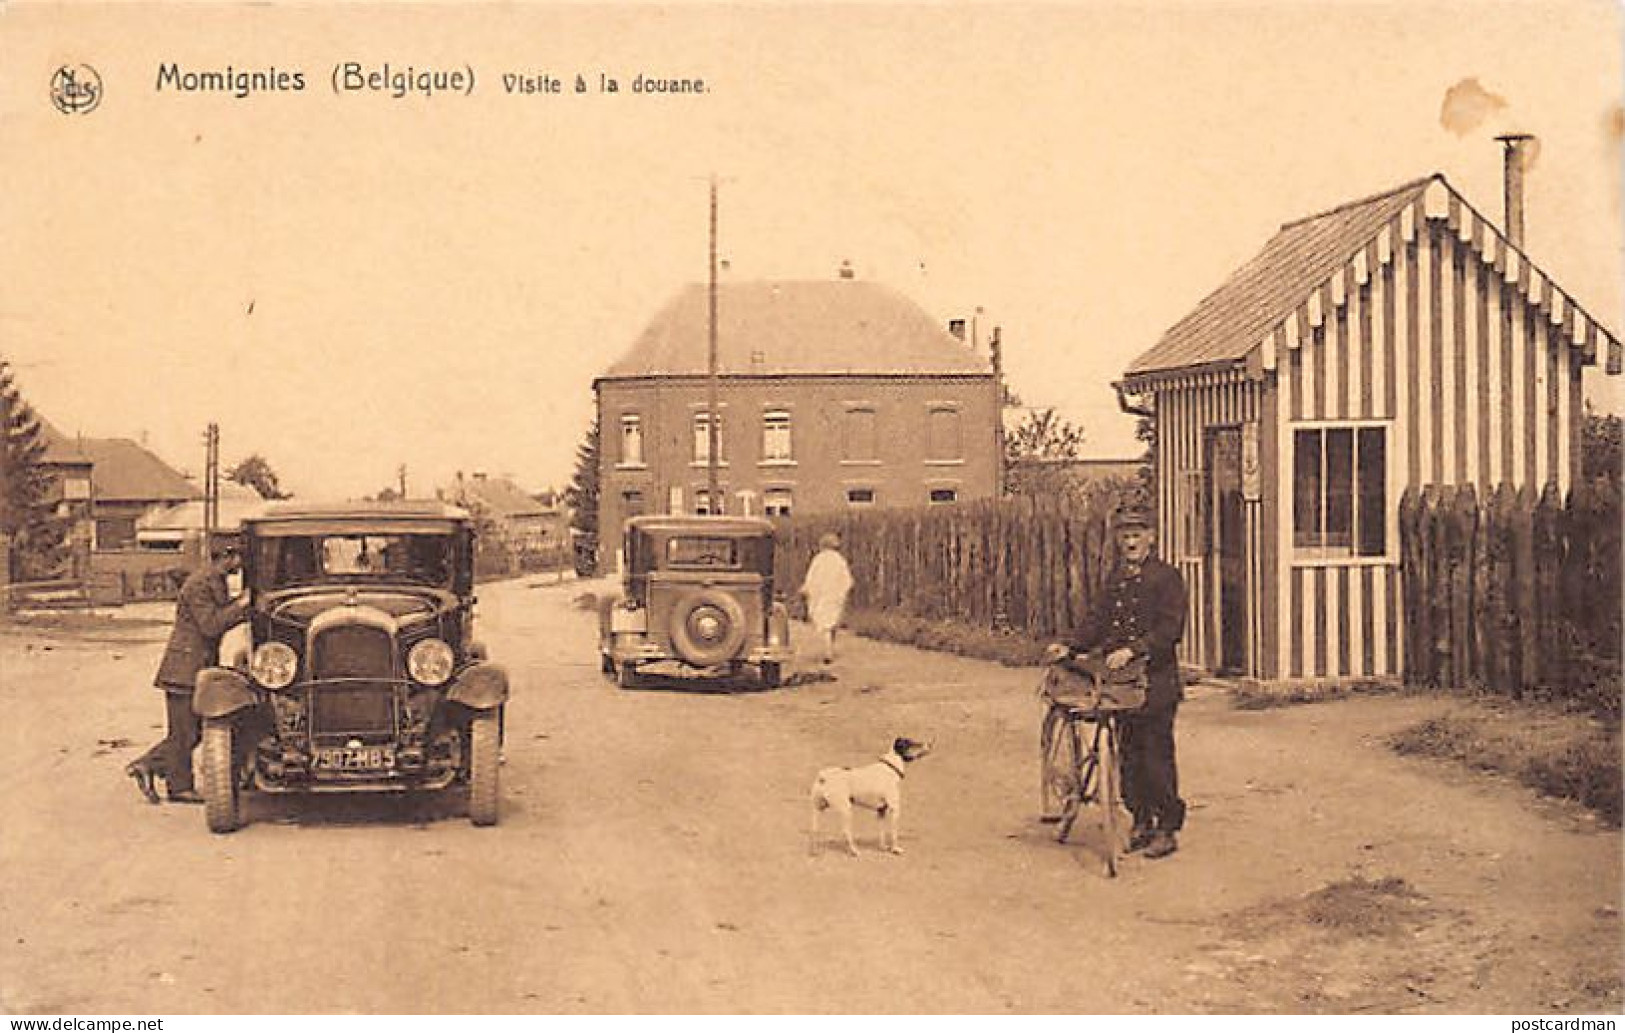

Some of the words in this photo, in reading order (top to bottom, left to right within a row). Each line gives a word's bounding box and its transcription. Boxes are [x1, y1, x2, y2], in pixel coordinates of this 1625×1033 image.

[155, 63, 307, 99] Momignies
[331, 62, 475, 99] (Belgique)
[502, 73, 561, 94] Visite
[574, 74, 588, 93] à
[601, 74, 619, 93] la
[631, 74, 712, 93] douane.
